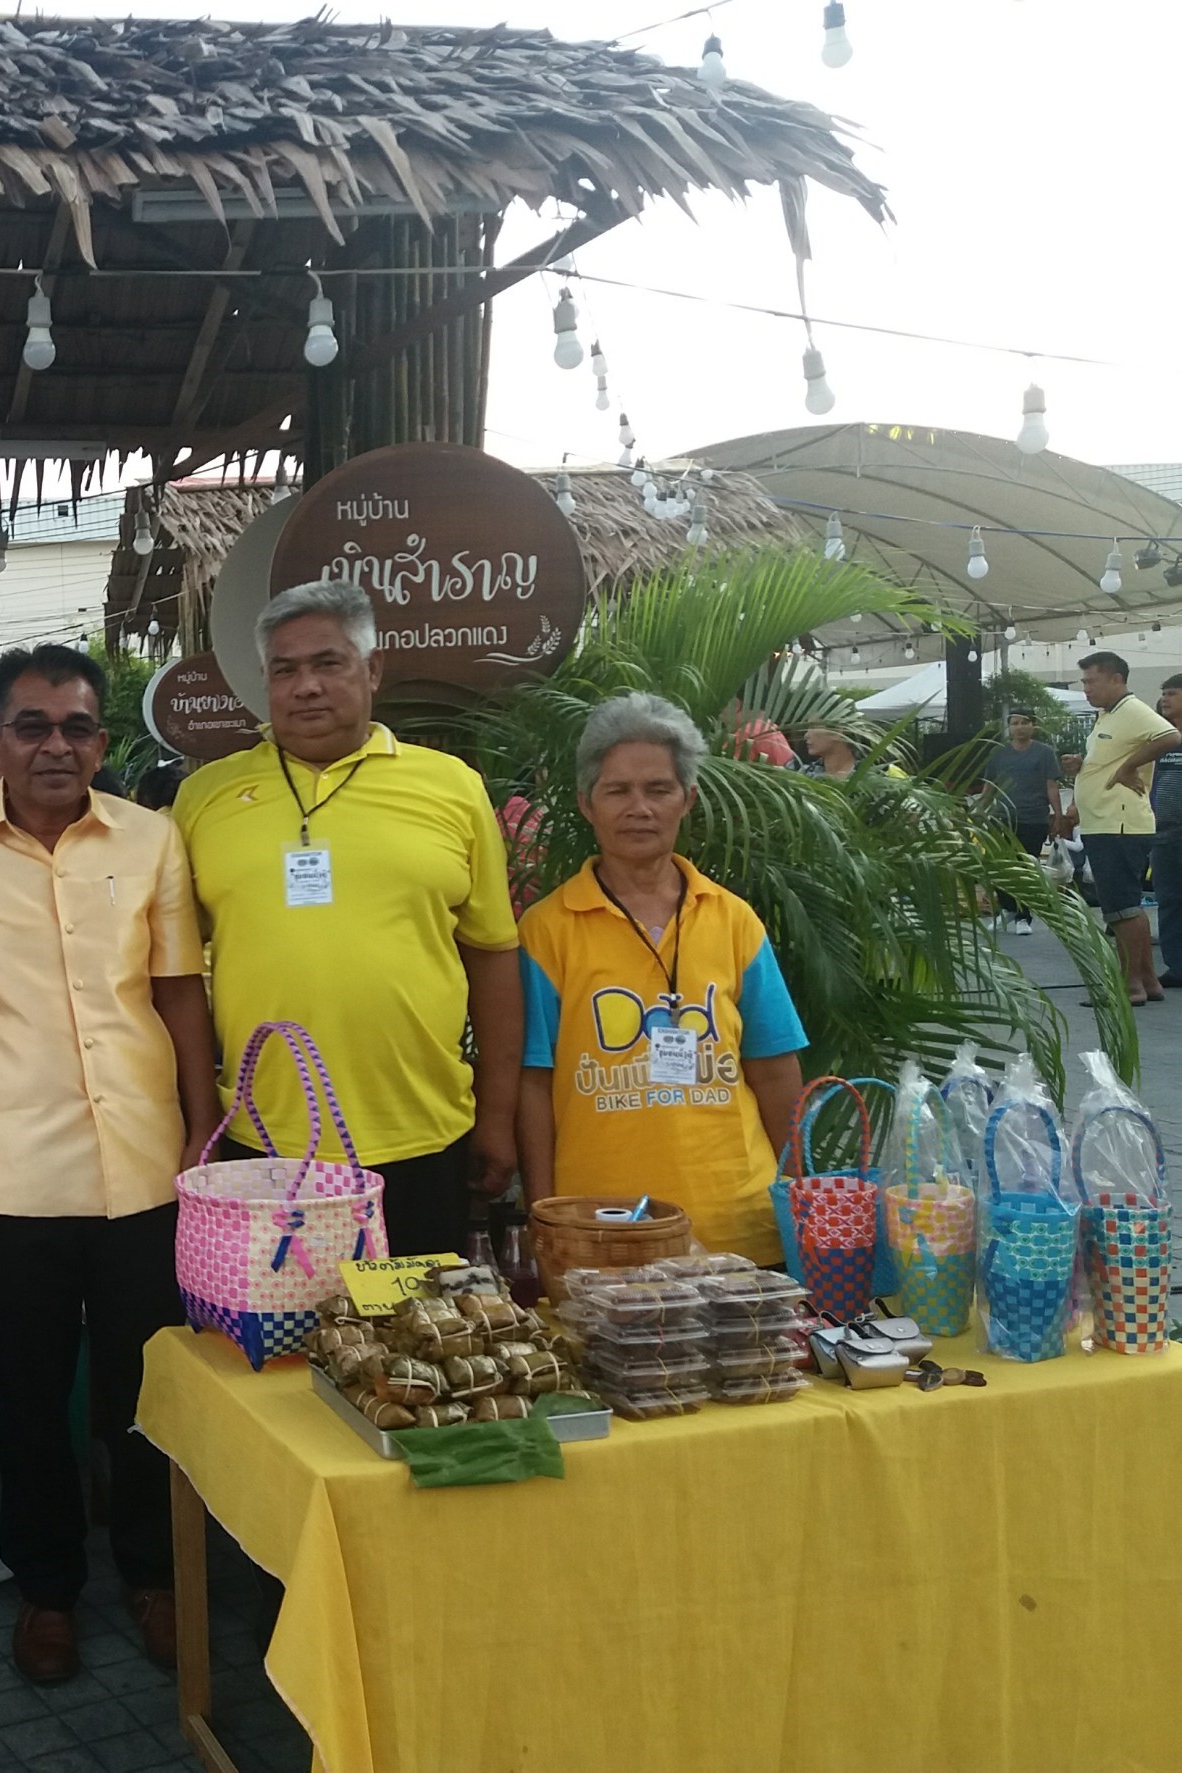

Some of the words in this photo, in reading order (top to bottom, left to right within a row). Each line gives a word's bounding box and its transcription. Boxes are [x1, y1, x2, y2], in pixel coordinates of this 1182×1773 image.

[337, 492, 409, 526] หมู่บ้าน
[377, 623, 507, 649] เภอปลวกแดง
[177, 671, 207, 684] หมู่บ้าน
[170, 692, 244, 714] บ้านยางเอ
[596, 1093, 642, 1112] BIKE
[647, 1089, 685, 1105] FOR
[692, 1087, 731, 1104] DAD
[392, 1276, 420, 1296] 10
